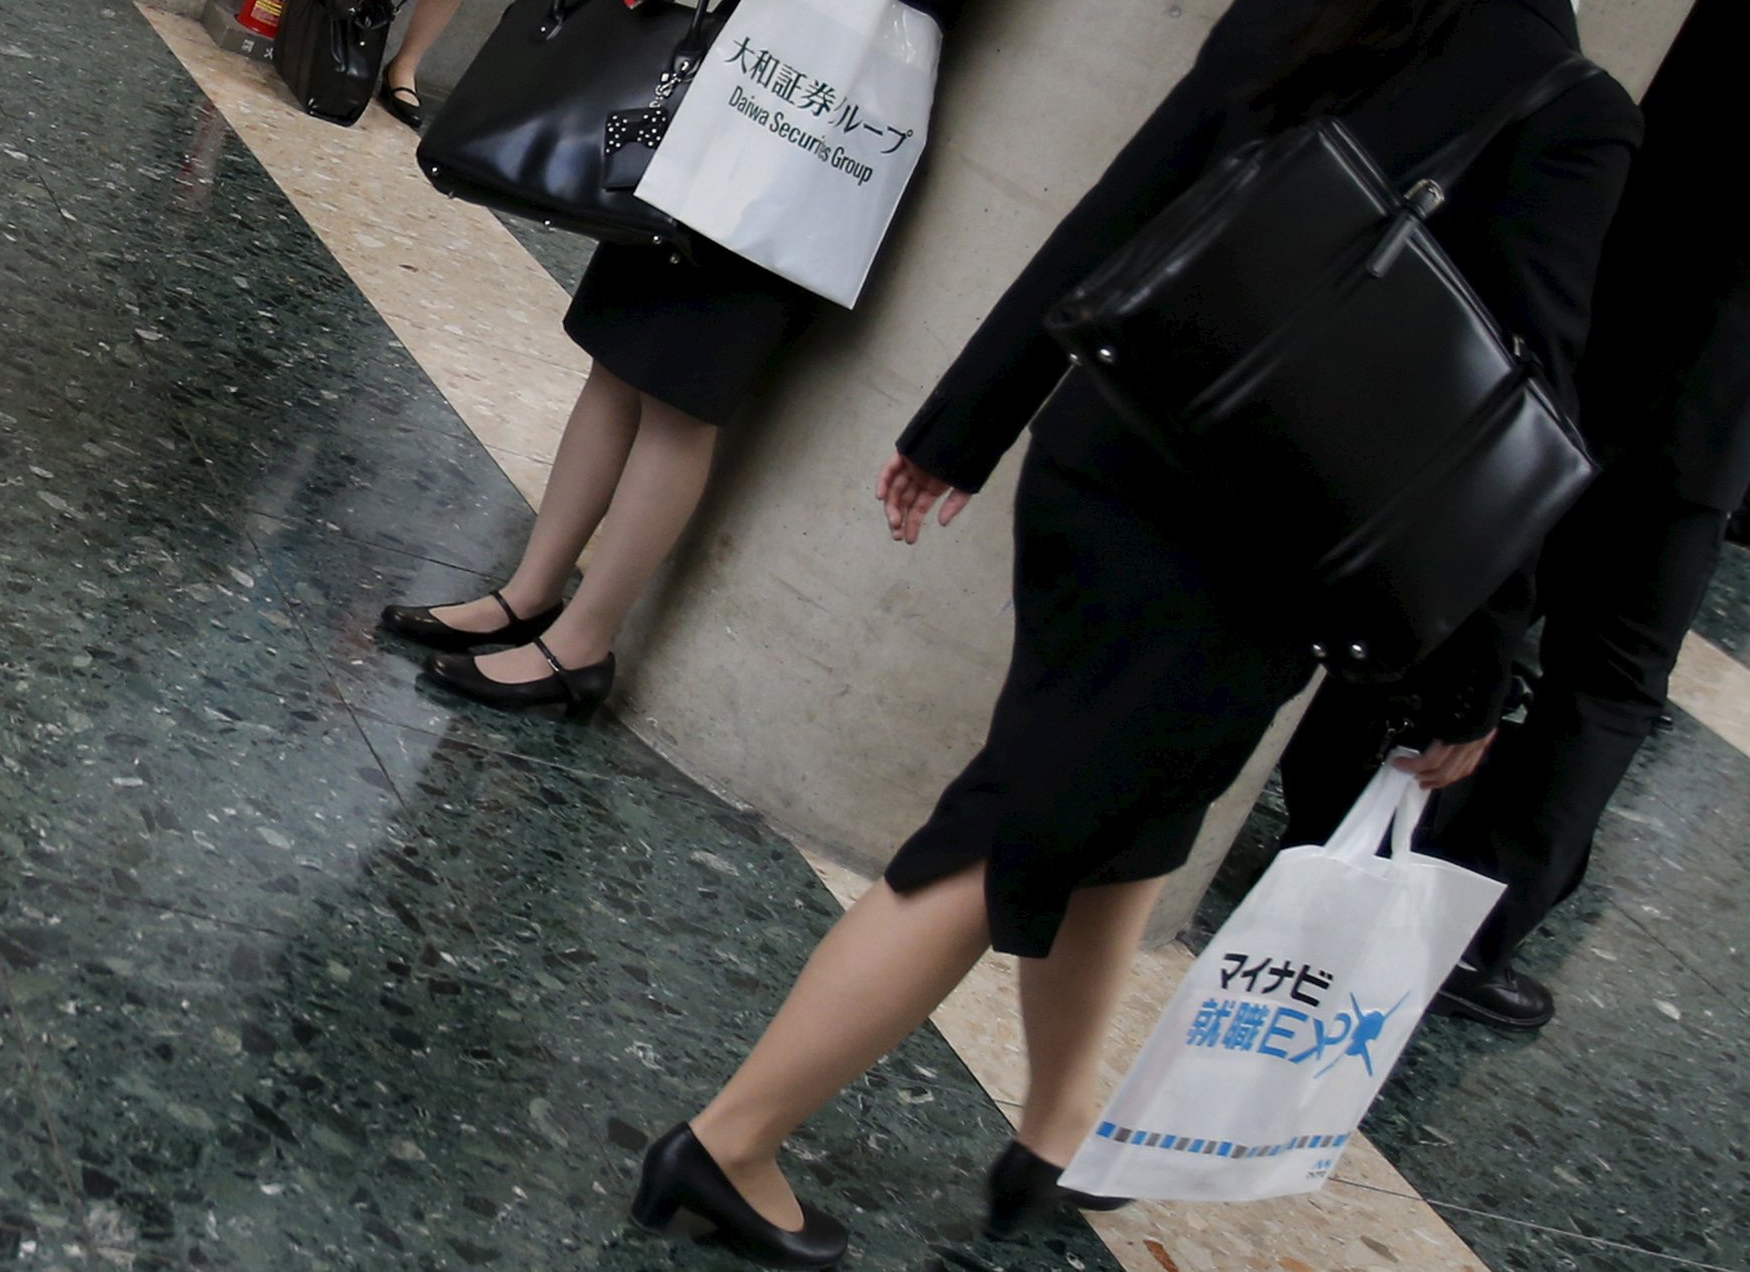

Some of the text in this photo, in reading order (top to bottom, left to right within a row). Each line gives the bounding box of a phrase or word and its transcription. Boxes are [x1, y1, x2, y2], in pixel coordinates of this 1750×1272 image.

[728, 85, 769, 126] Daiwa
[831, 146, 874, 186] Group
[1220, 953, 1334, 1008] マイナビ
